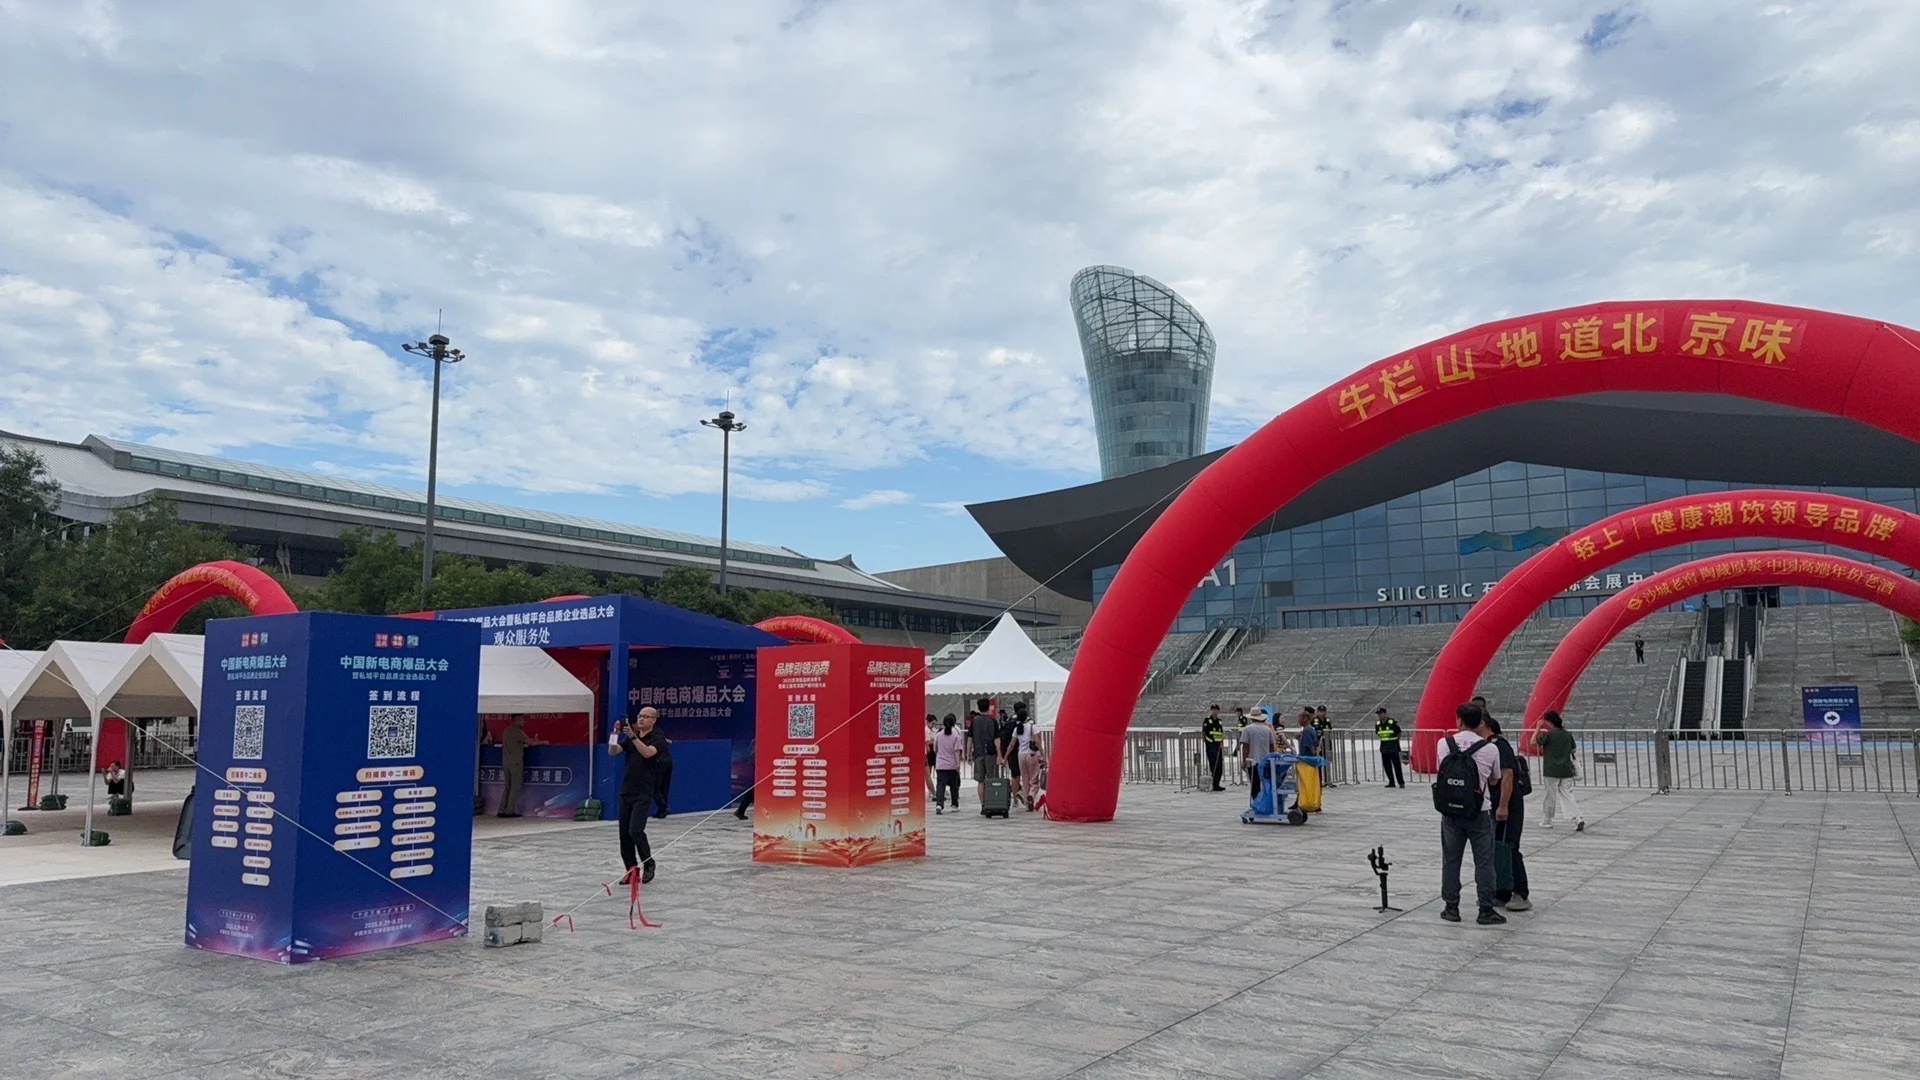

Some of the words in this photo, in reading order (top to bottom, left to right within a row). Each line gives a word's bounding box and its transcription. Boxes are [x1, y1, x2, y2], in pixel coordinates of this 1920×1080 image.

[1338, 312, 1793, 421] 牛栏山地道北京味
[494, 627, 550, 646] 观众服务处
[221, 654, 287, 671] 中国新电商爆品大会
[340, 655, 449, 671] 中国新电商爆品大会
[368, 690, 420, 701] 签到流程
[628, 685, 745, 705] 中国新电商爆品大会
[1447, 778, 1465, 786] EOS
